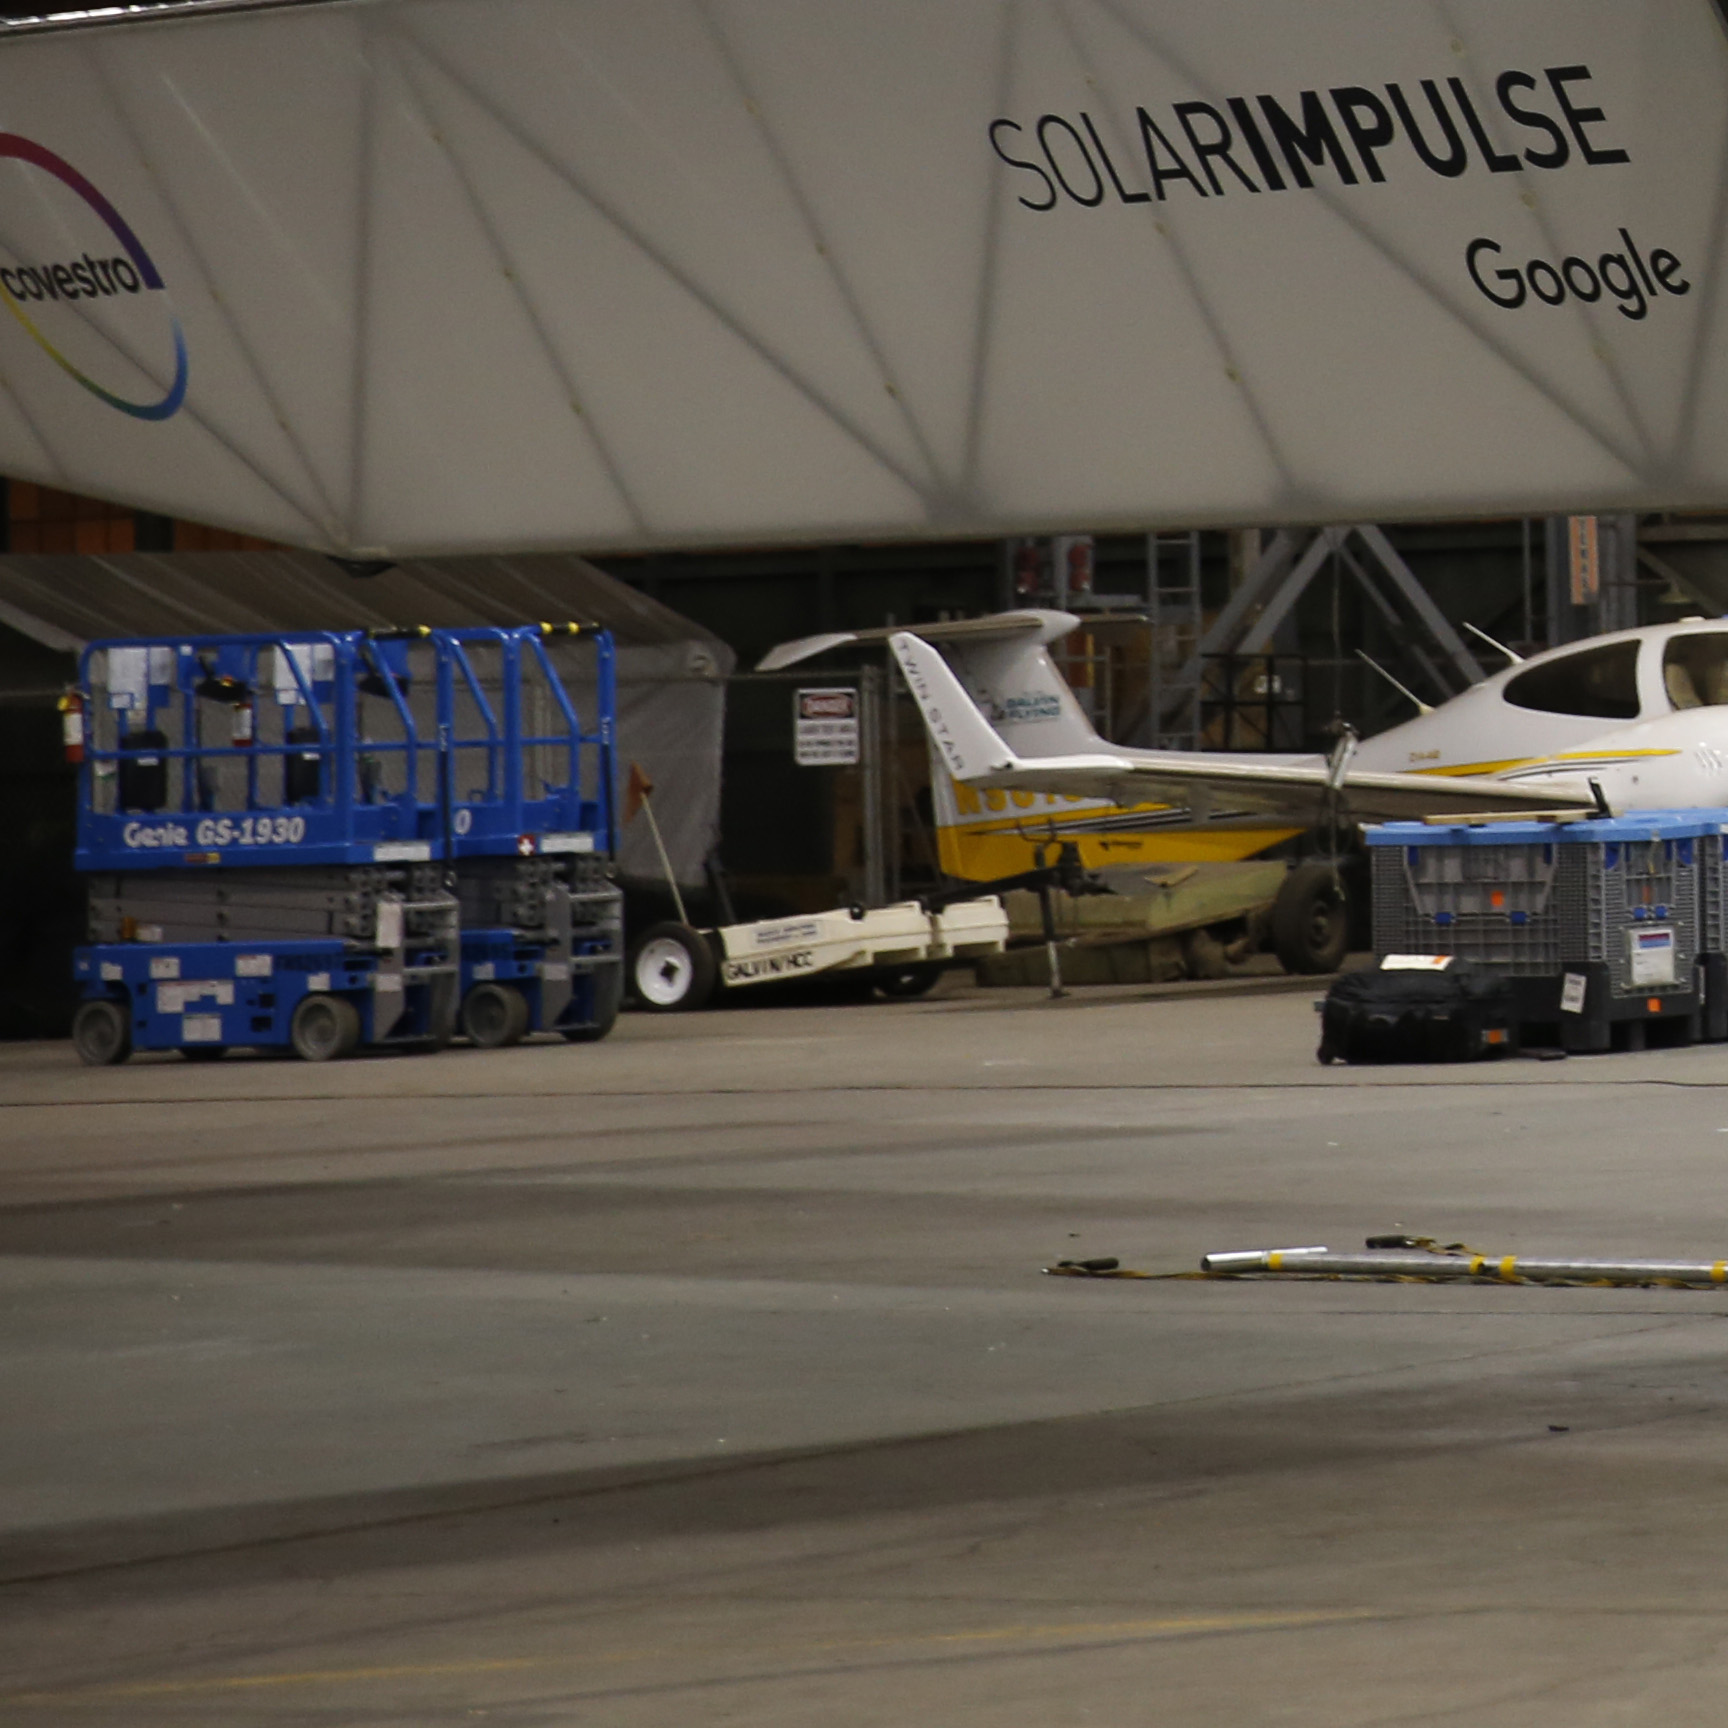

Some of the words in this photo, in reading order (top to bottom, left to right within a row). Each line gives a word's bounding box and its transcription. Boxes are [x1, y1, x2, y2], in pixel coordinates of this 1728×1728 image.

[988, 64, 1631, 213] SOLARIMPULSE
[0, 253, 140, 301] covestro
[1466, 227, 1691, 320] Google
[123, 821, 189, 848] Genie
[195, 816, 306, 846] GS-1930
